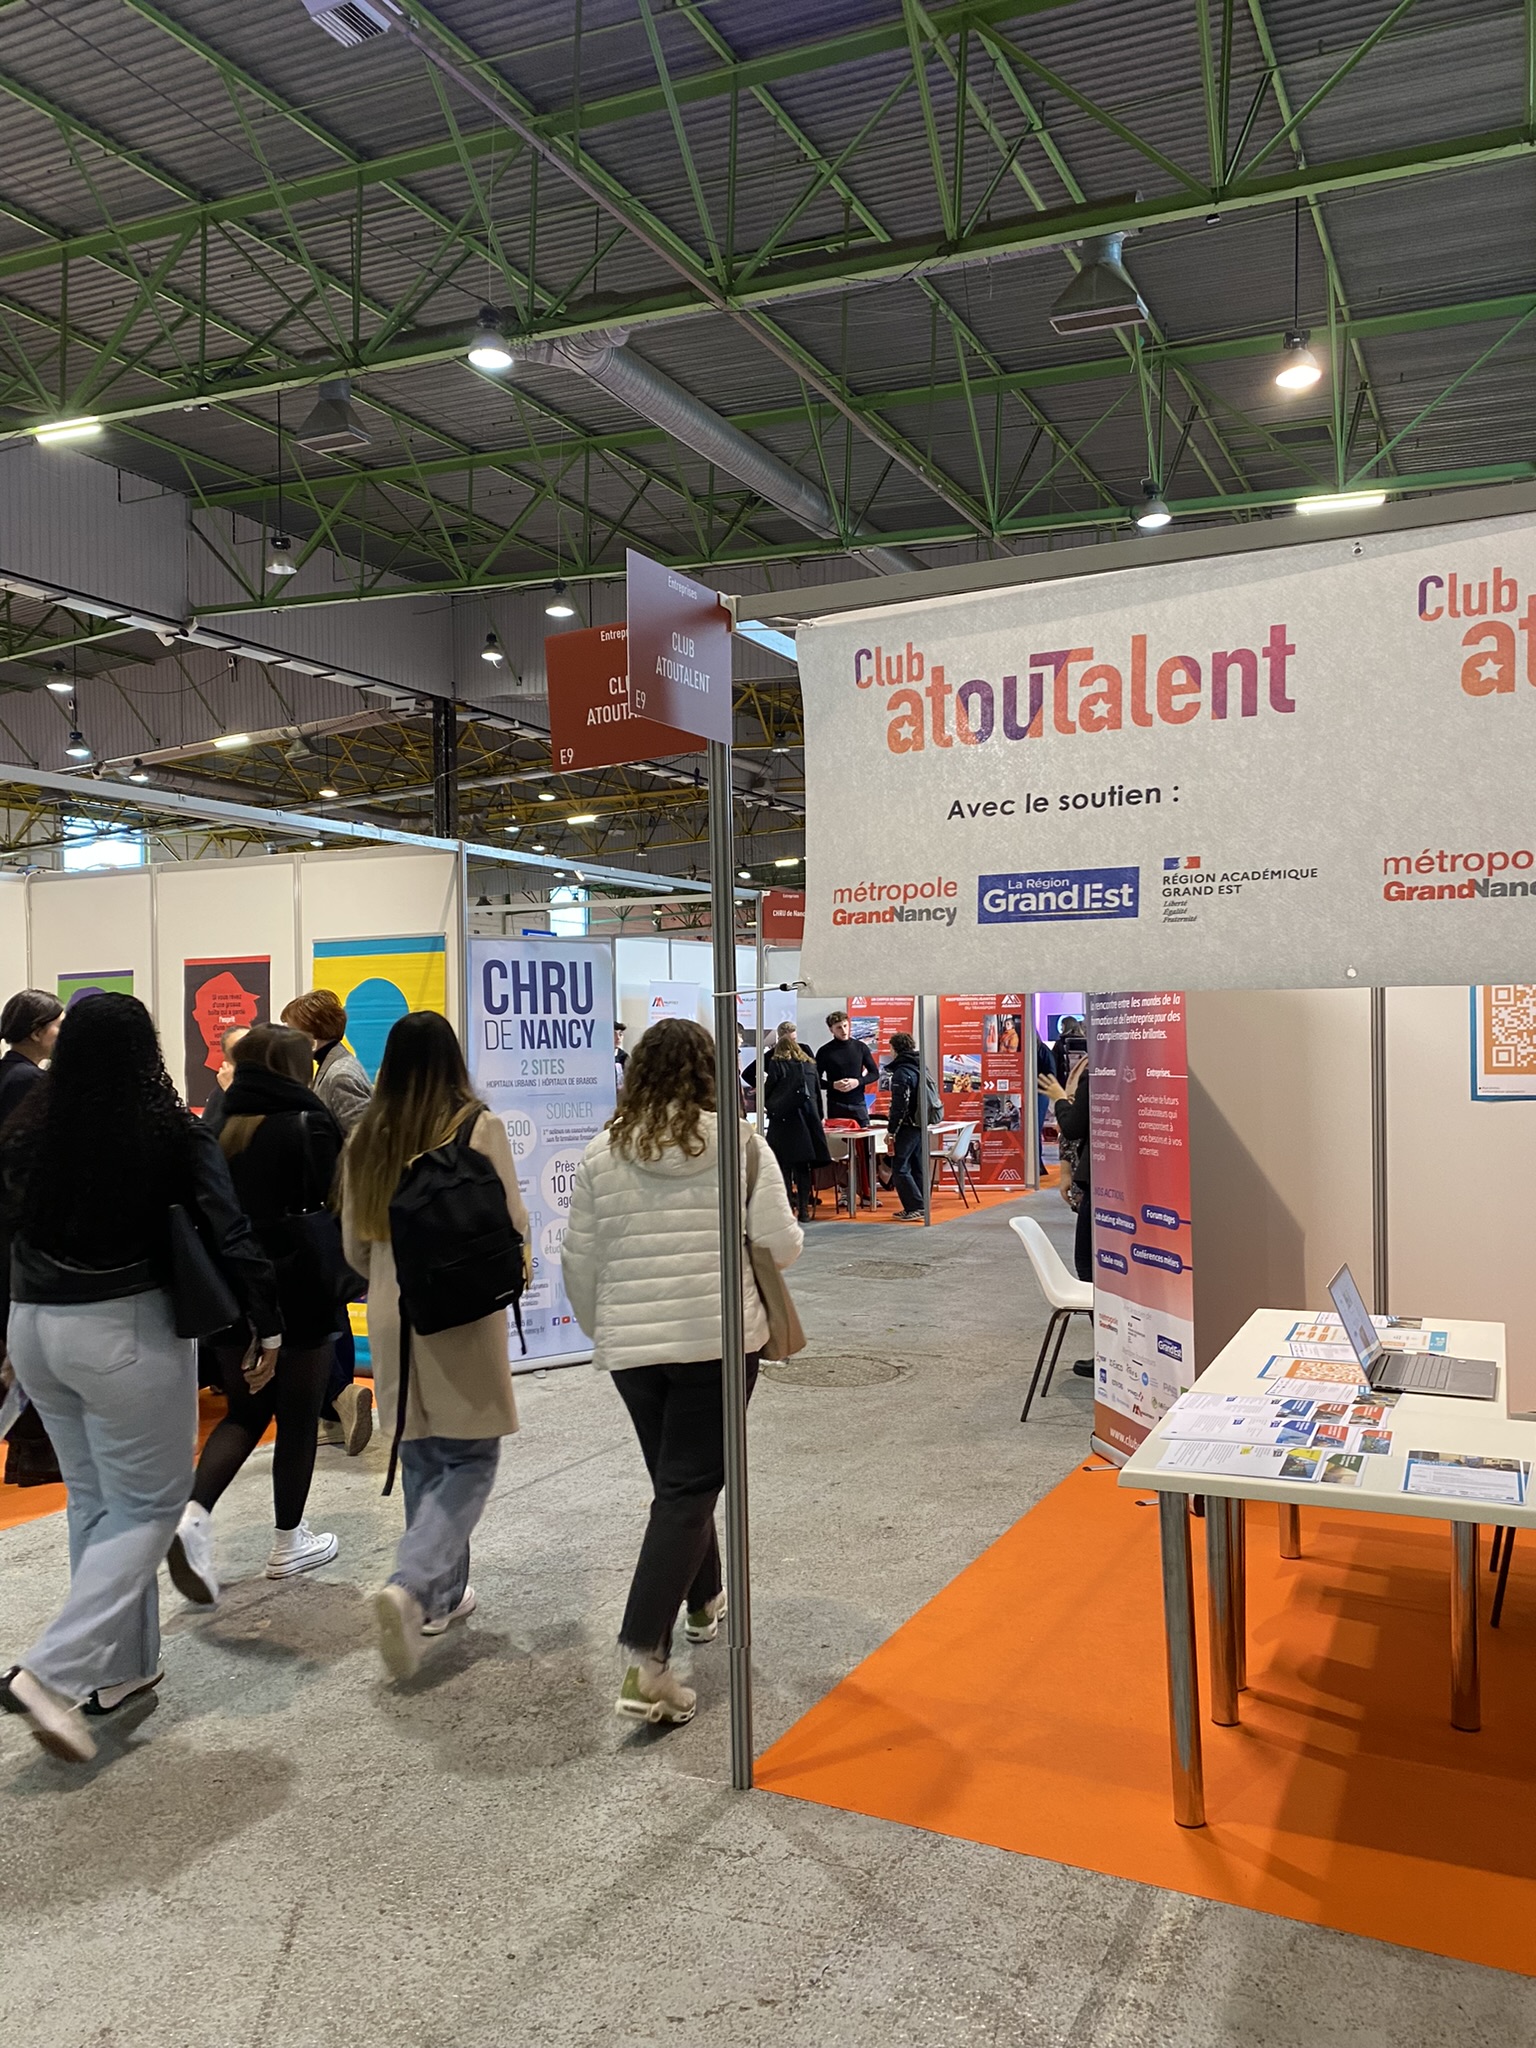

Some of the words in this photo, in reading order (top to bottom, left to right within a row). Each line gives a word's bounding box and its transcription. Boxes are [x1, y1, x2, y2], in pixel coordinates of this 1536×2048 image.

[668, 576, 698, 600] Entreprises
[1418, 566, 1518, 621] Club
[600, 627, 627, 642] Entrep
[672, 631, 695, 658] CLUB
[655, 655, 710, 694] ATOUTALENT
[855, 642, 924, 689] Club
[886, 624, 1296, 754] atouTalent
[635, 689, 646, 709] E9
[560, 748, 574, 765] E9
[947, 800, 1016, 820] Avec
[1025, 793, 1049, 813] le
[1059, 784, 1161, 811] soutien
[1383, 848, 1534, 877] métropo
[1008, 880, 1022, 889] La
[1026, 877, 1070, 890] Région
[1163, 873, 1216, 885] RÉGION
[1220, 868, 1318, 882] ACADÉMIQUE
[833, 876, 958, 904] métropole
[1162, 886, 1213, 897] GRAND
[1218, 884, 1242, 894] EST
[1163, 899, 1188, 907] Liberté
[772, 909, 786, 917] CHRU
[832, 905, 957, 927] GrandNancy
[1163, 915, 1197, 923] Fraternité
[482, 959, 594, 1016] CHRU
[1131, 996, 1140, 1008] les
[1162, 993, 1171, 1006] de
[1172, 992, 1180, 1005] la
[1167, 1009, 1181, 1022] des
[485, 1020, 513, 1050] DE
[520, 1019, 595, 1050] NANCY
[1096, 1027, 1141, 1043] complémentarités
[521, 1059, 528, 1076] 2
[532, 1058, 565, 1076] SITES
[515, 1078, 537, 1087] URBAINS
[569, 1077, 575, 1085] DE
[576, 1077, 598, 1085] BRABOIS
[546, 1101, 594, 1119] SOIGNER
[507, 1119, 531, 1137] 500
[1172, 1138, 1183, 1147] vos
[555, 1160, 576, 1173] Près
[551, 1174, 566, 1193] 10
[1146, 1209, 1162, 1220] Forum
[1133, 1247, 1163, 1263] Conférences
